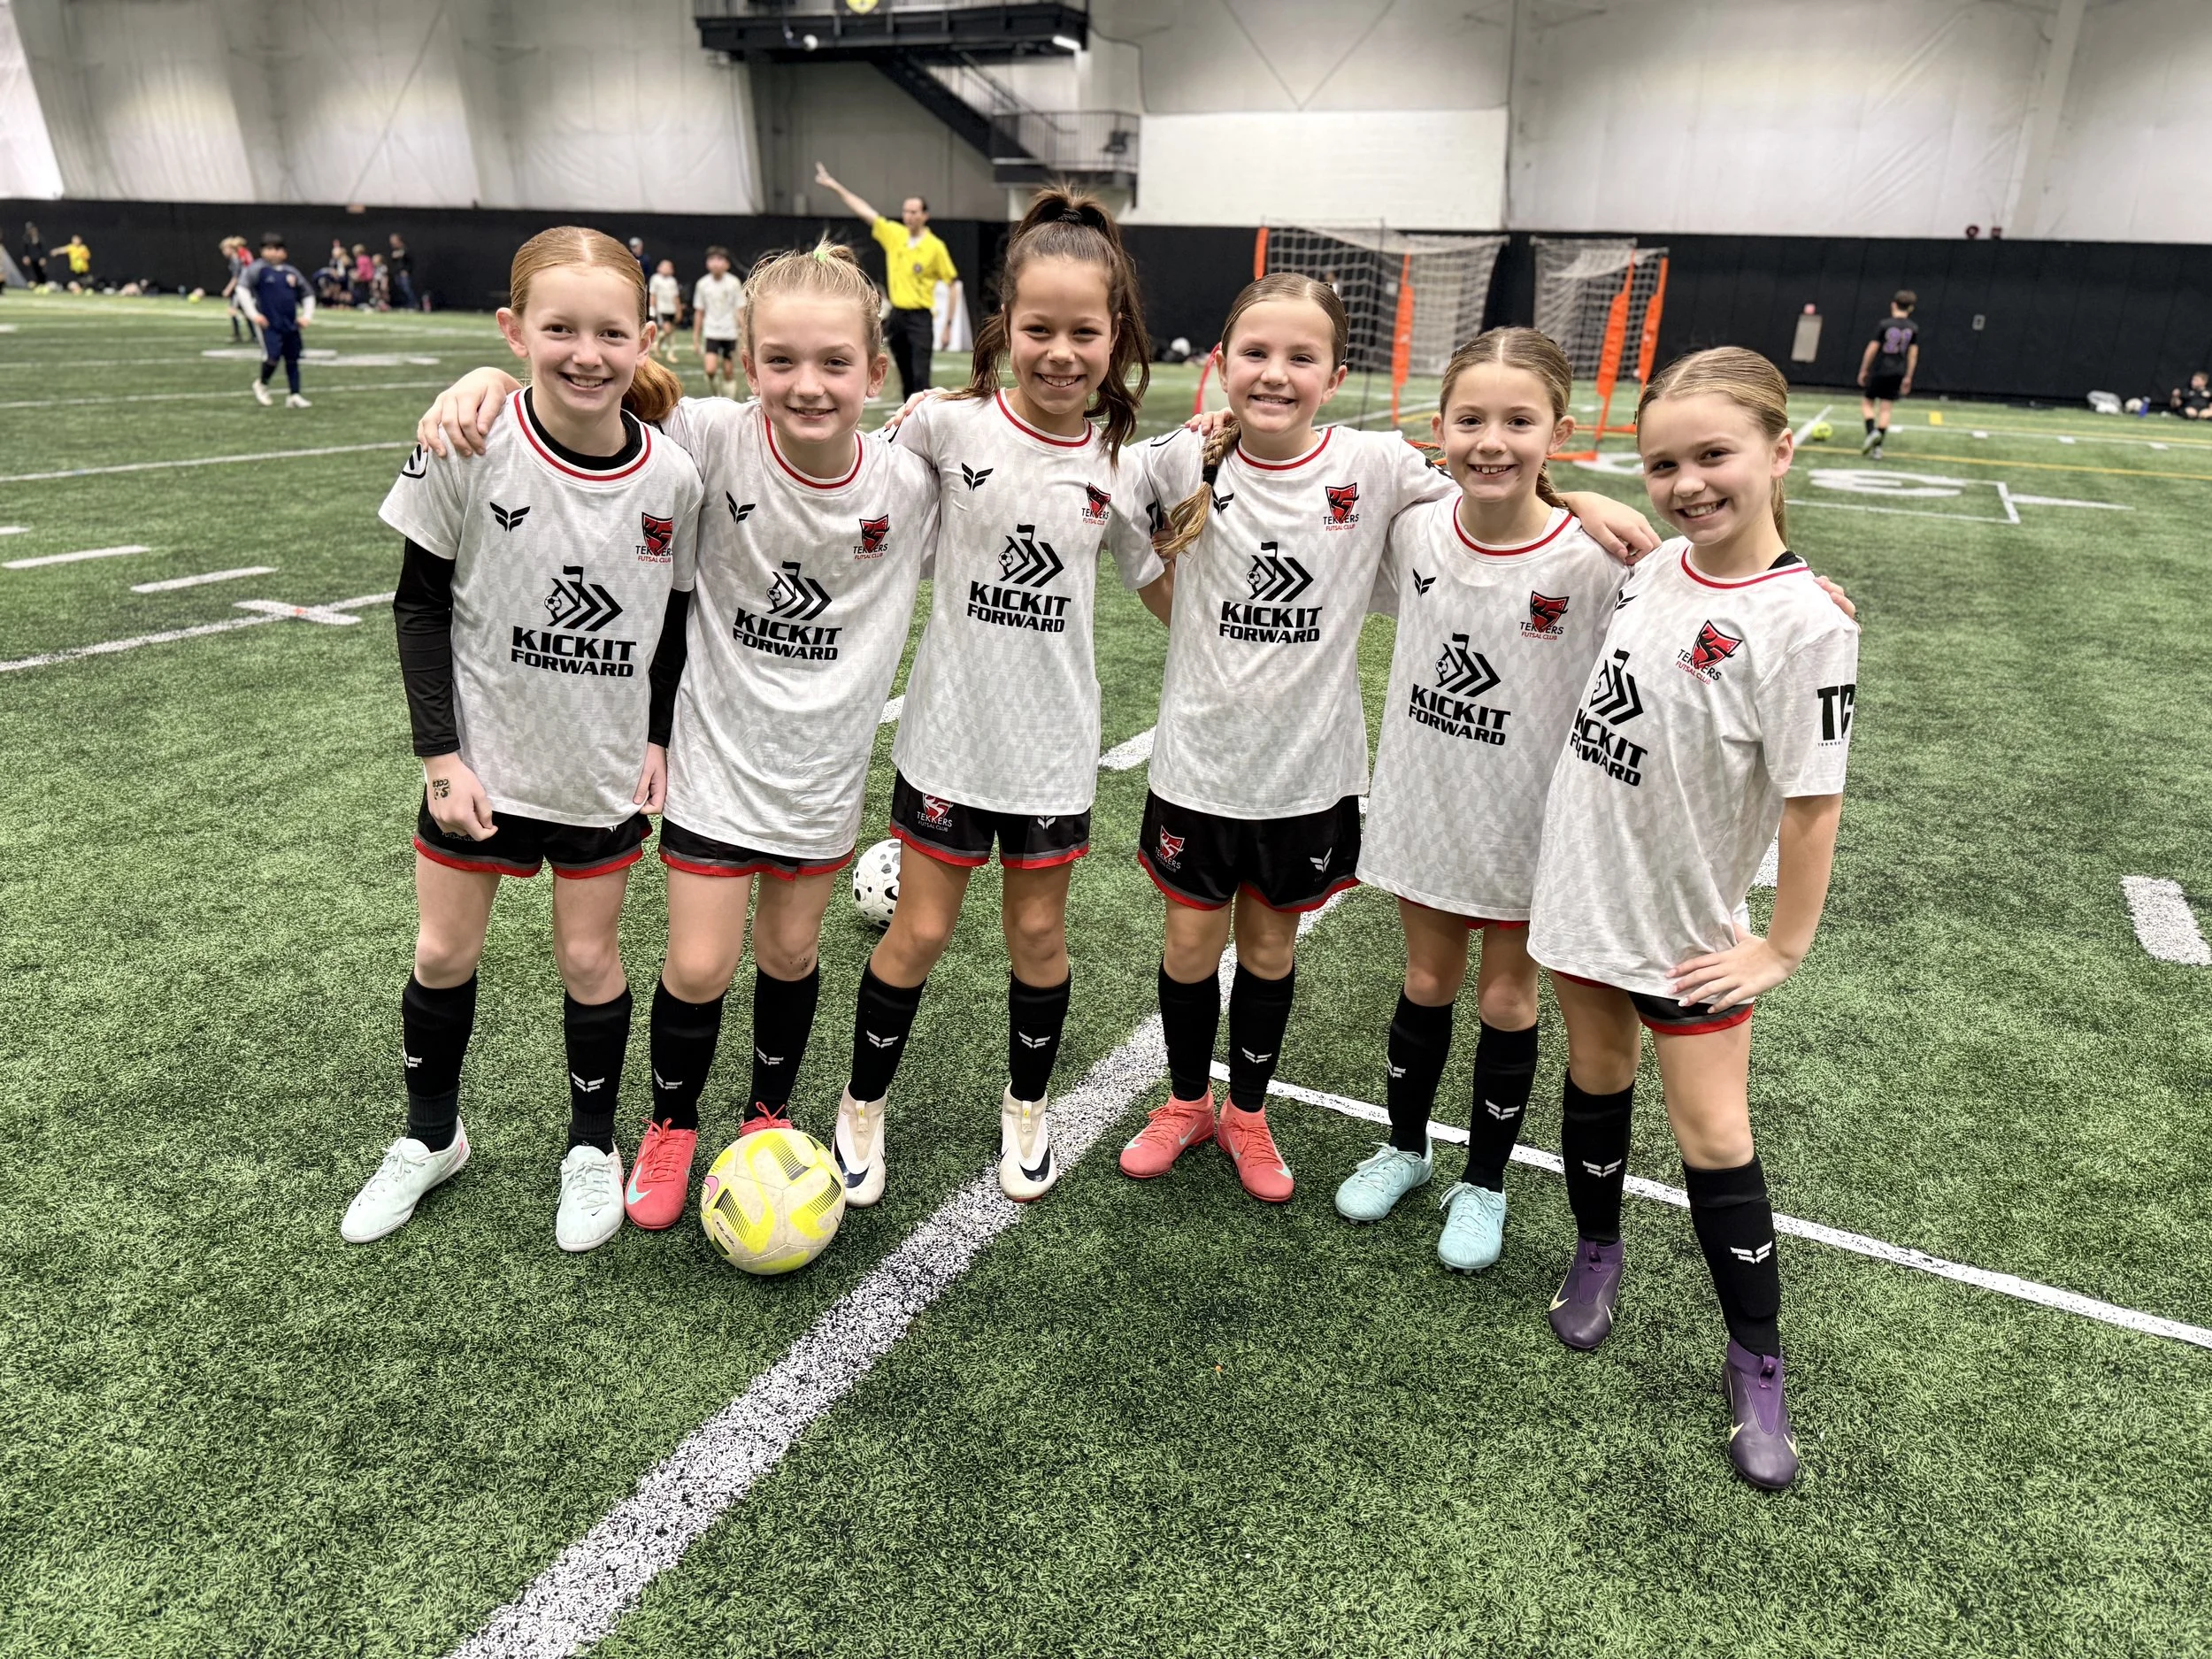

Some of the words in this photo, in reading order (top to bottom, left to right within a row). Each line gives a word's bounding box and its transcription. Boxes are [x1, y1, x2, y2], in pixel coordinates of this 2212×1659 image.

[1081, 508, 1109, 519] TEKERS
[1323, 514, 1360, 525] TEKERS
[635, 545, 672, 557] TEKER
[853, 543, 888, 554] TEKERS
[969, 580, 1071, 617] KICKIT
[733, 607, 842, 646] KICKIT
[966, 603, 1065, 633] FORWARD
[1220, 601, 1323, 629] KICKIT
[1520, 621, 1564, 635] TEKERS
[511, 626, 637, 662] KICKIT
[733, 626, 838, 661] FORWARD
[1219, 622, 1320, 644] FORWARD
[511, 648, 634, 678] FORWARD
[1675, 660, 1696, 677] FUTSAL
[1696, 672, 1711, 685] CLUB
[1410, 683, 1511, 730] KICKIT
[1816, 684, 1856, 741] TC
[1408, 704, 1506, 746] FORWARD
[1574, 708, 1648, 769] KCKIT
[1570, 732, 1641, 787] FWARD
[917, 810, 953, 827] TEKKERS
